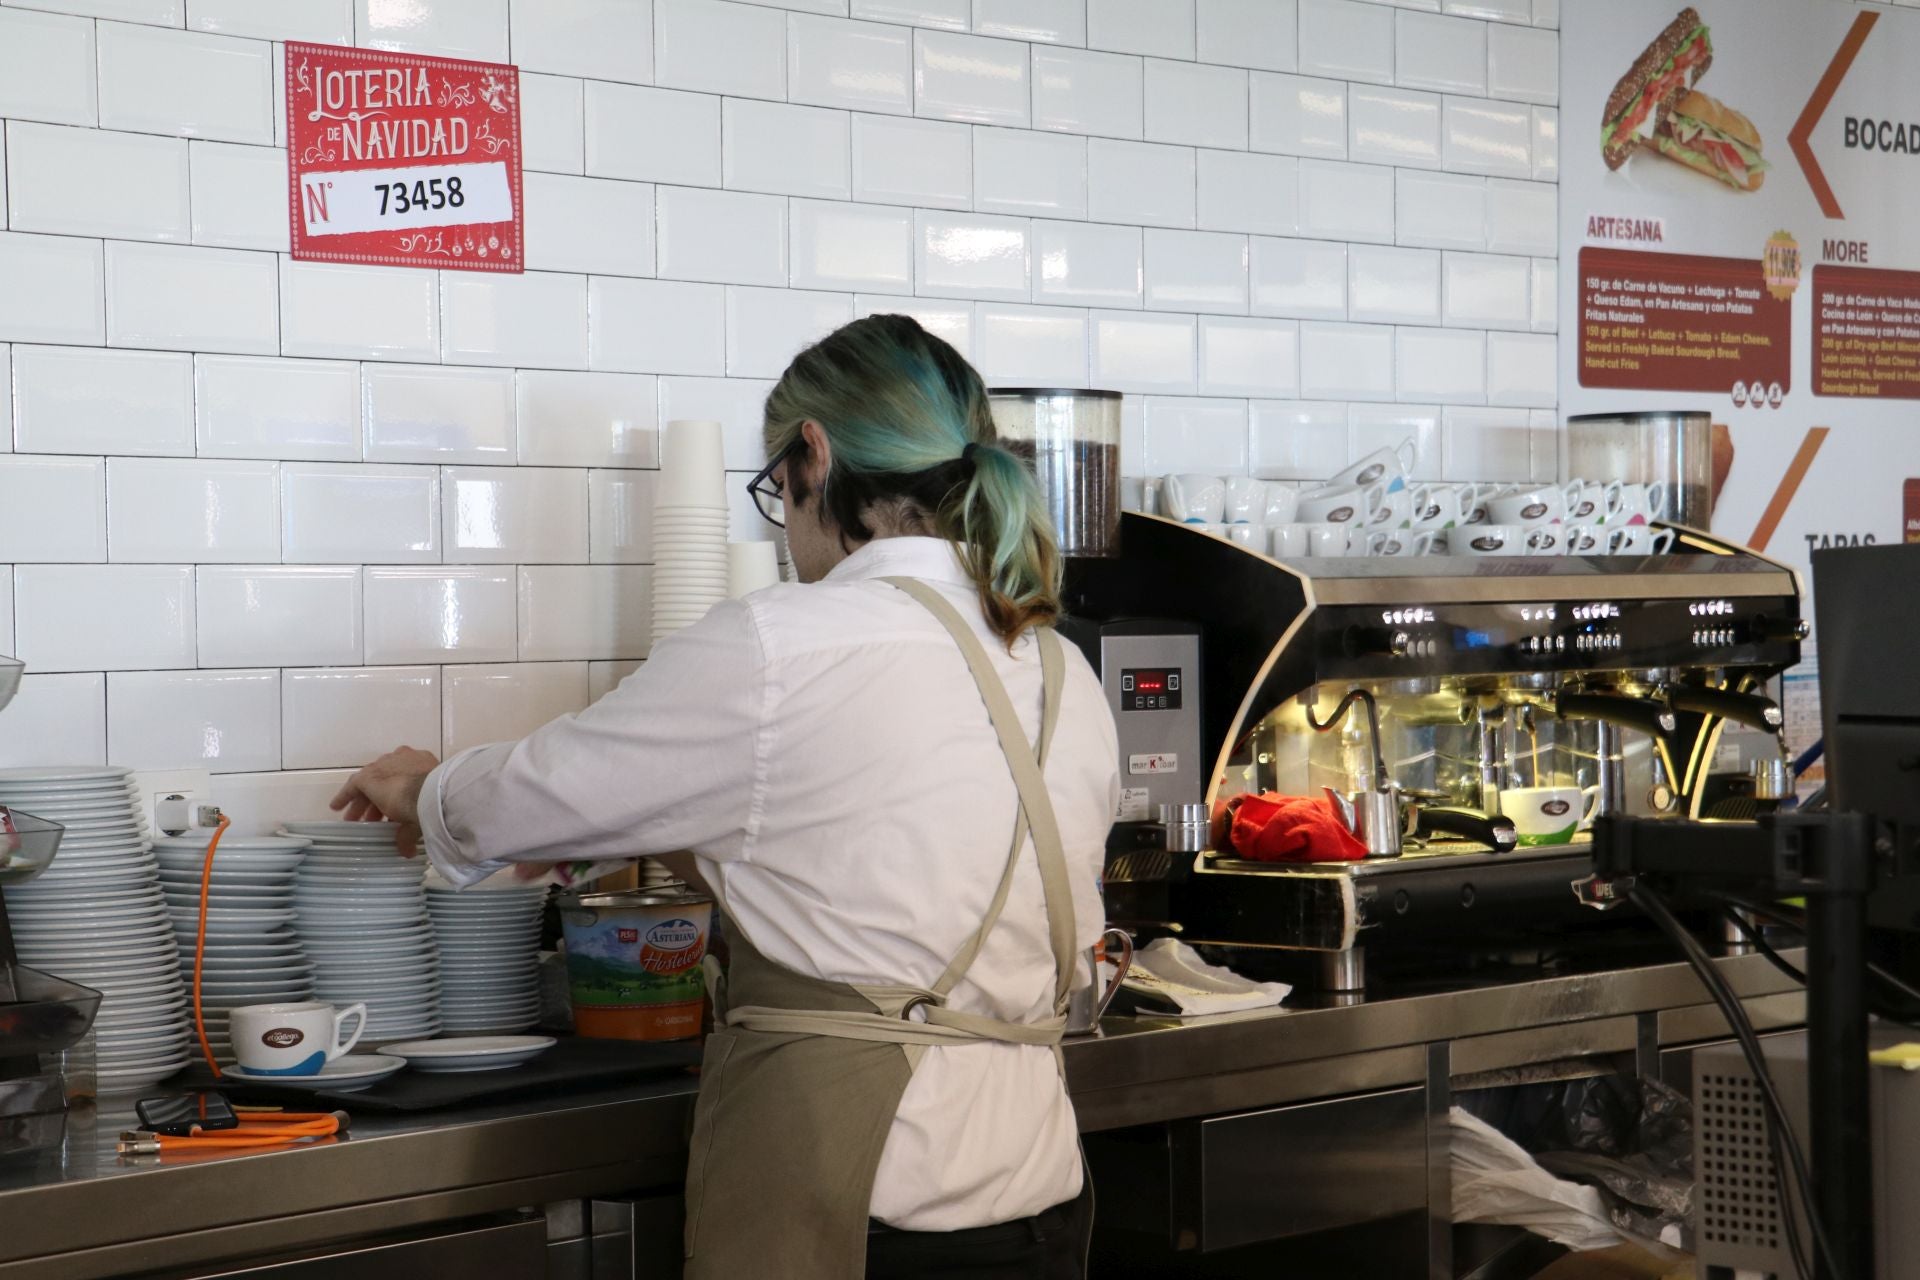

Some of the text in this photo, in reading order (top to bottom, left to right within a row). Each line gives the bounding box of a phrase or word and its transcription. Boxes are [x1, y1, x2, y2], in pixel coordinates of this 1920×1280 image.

[311, 66, 432, 114] LOTERIA
[327, 115, 469, 161] DE NAVIDAD
[375, 176, 464, 216] 73458
[1587, 216, 1663, 242] ARTESANA
[1822, 239, 1869, 263] MORE
[1586, 278, 1599, 288] 150
[1612, 279, 1622, 290] de
[1624, 280, 1646, 291] Carne
[1648, 281, 1656, 292] de
[1658, 282, 1685, 294] Vacuno
[1694, 285, 1726, 299] Lechuga
[1734, 288, 1760, 299] Tomate
[1594, 294, 1618, 306] Queso
[1656, 298, 1670, 308] Pan
[1671, 298, 1704, 310] Artesano
[1705, 303, 1710, 314] y
[1712, 303, 1724, 312] con
[1726, 302, 1753, 314] Patatas
[1856, 296, 1875, 307] Carne
[1586, 309, 1644, 323] Fritas Naturales
[1586, 326, 1598, 336] 150
[1586, 342, 1612, 352] Served
